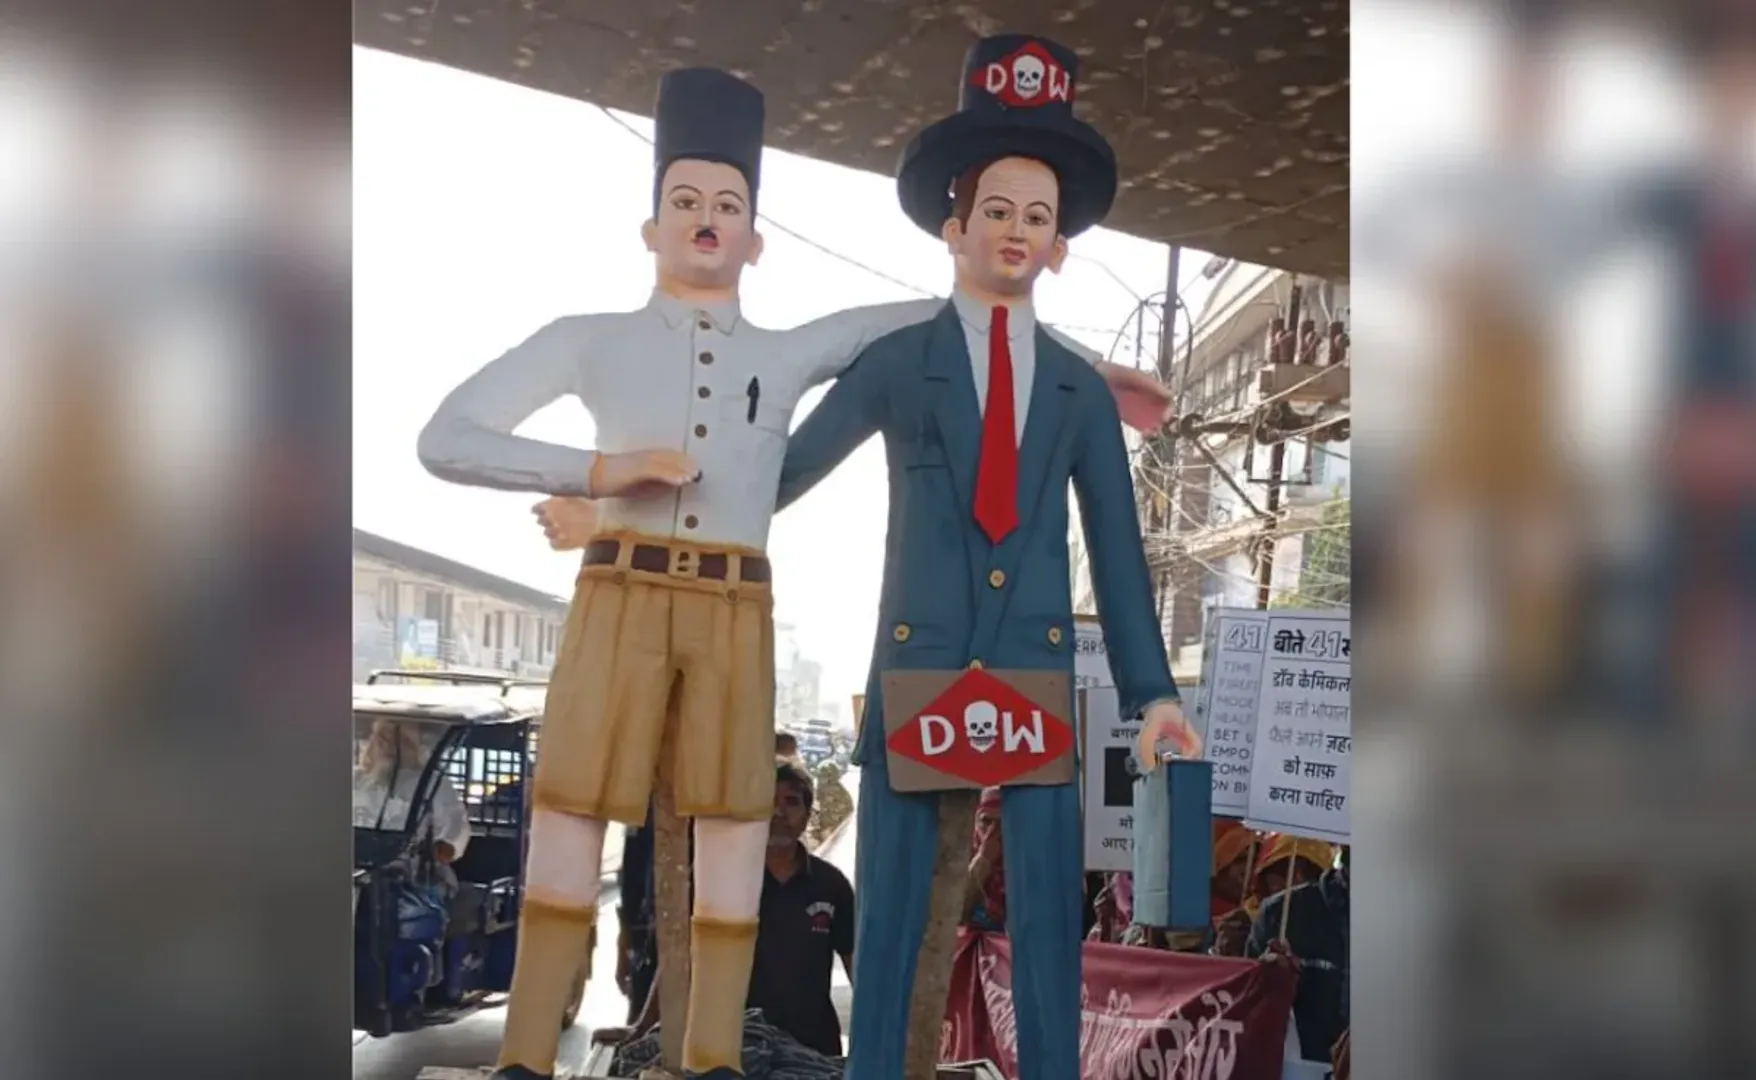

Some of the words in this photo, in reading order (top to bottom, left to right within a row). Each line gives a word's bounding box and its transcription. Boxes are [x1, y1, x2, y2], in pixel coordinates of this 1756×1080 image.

[1223, 625, 1261, 649] 41
[1273, 629, 1306, 654] बीते
[1305, 630, 1341, 658] 41
[1298, 669, 1350, 691] केमिकल
[1214, 728, 1238, 741] SET
[1283, 755, 1300, 776] को
[1269, 786, 1302, 805] करना
[1304, 789, 1345, 811] चाहिए
